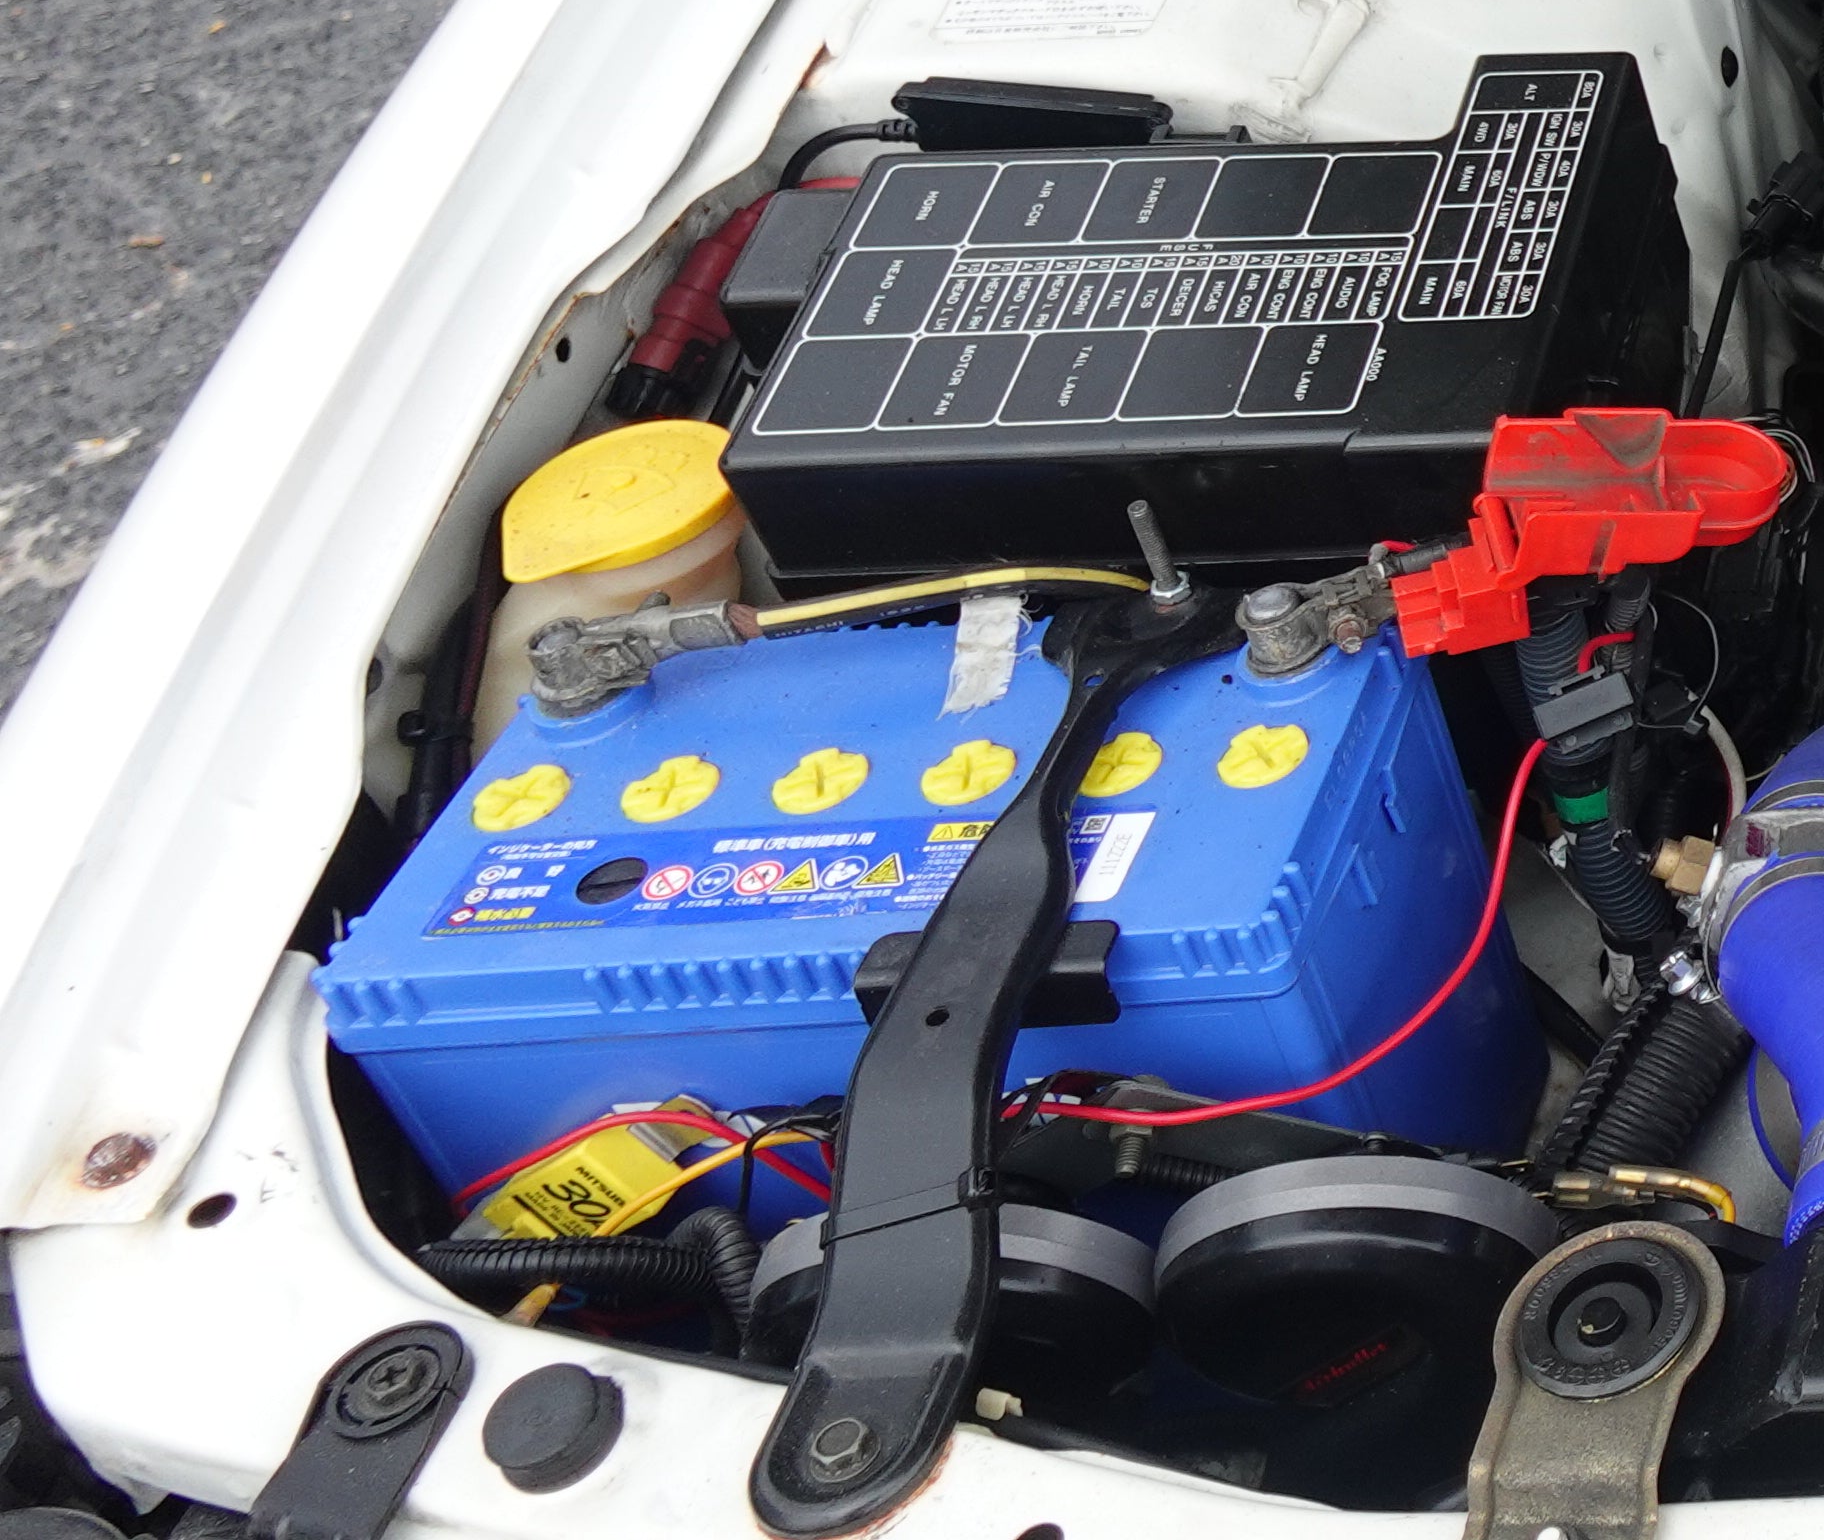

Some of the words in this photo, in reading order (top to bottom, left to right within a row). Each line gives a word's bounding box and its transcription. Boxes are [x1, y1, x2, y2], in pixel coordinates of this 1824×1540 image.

[1523, 83, 1538, 102] ALT
[1474, 121, 1489, 143] 4WD
[1503, 122, 1519, 141] 30A
[1569, 120, 1584, 138] 30A
[1457, 164, 1476, 192] MAIN
[1488, 169, 1503, 188] 60A
[1531, 152, 1552, 188] P/WDW
[1558, 159, 1572, 179] 40A
[1037, 179, 1056, 198] AIR
[1136, 177, 1167, 224] STARTER
[915, 190, 940, 221] HORN
[1023, 203, 1044, 227] CON
[1494, 187, 1518, 229] F/LINK
[1520, 199, 1537, 221] ABS
[1545, 200, 1560, 220] 30A
[1507, 240, 1524, 263] ABS
[1532, 241, 1547, 261] 30A
[880, 259, 904, 289] HEAD
[1245, 273, 1261, 290] AIR
[1280, 269, 1295, 292] ENG
[1312, 268, 1327, 290] ENG
[1375, 267, 1392, 288] FOG
[946, 278, 968, 305] HEAD
[979, 277, 1001, 303] HEAD
[1013, 276, 1034, 303] HEAD
[1046, 275, 1067, 301] HEAD
[1072, 285, 1094, 315] HORN
[1106, 288, 1126, 311] TAIL
[1140, 288, 1159, 308] TCS
[1169, 278, 1195, 317] DEICER
[1203, 280, 1226, 312] HICAS
[1335, 276, 1356, 308] AUDIO
[1419, 276, 1438, 305] MAIN
[1451, 280, 1467, 300] 60A
[1519, 284, 1534, 305] 30A
[862, 294, 885, 325] LAMP
[1233, 295, 1253, 318] CON
[1266, 293, 1287, 320] CONT
[1298, 292, 1319, 319] CONT
[1365, 290, 1384, 317] LAMP
[933, 316, 947, 331] LH
[966, 315, 983, 330] RH
[1000, 313, 1016, 328] LH
[1034, 312, 1050, 327] RH
[1072, 345, 1093, 370] TAIL
[1306, 333, 1328, 365] HEAD
[947, 344, 978, 385] MOTOR
[1365, 347, 1387, 381] AA000
[1056, 376, 1079, 407] LAMP
[1294, 370, 1313, 401] LAMP
[932, 392, 954, 416] FAN
[576, 1165, 626, 1207] MITSUB
